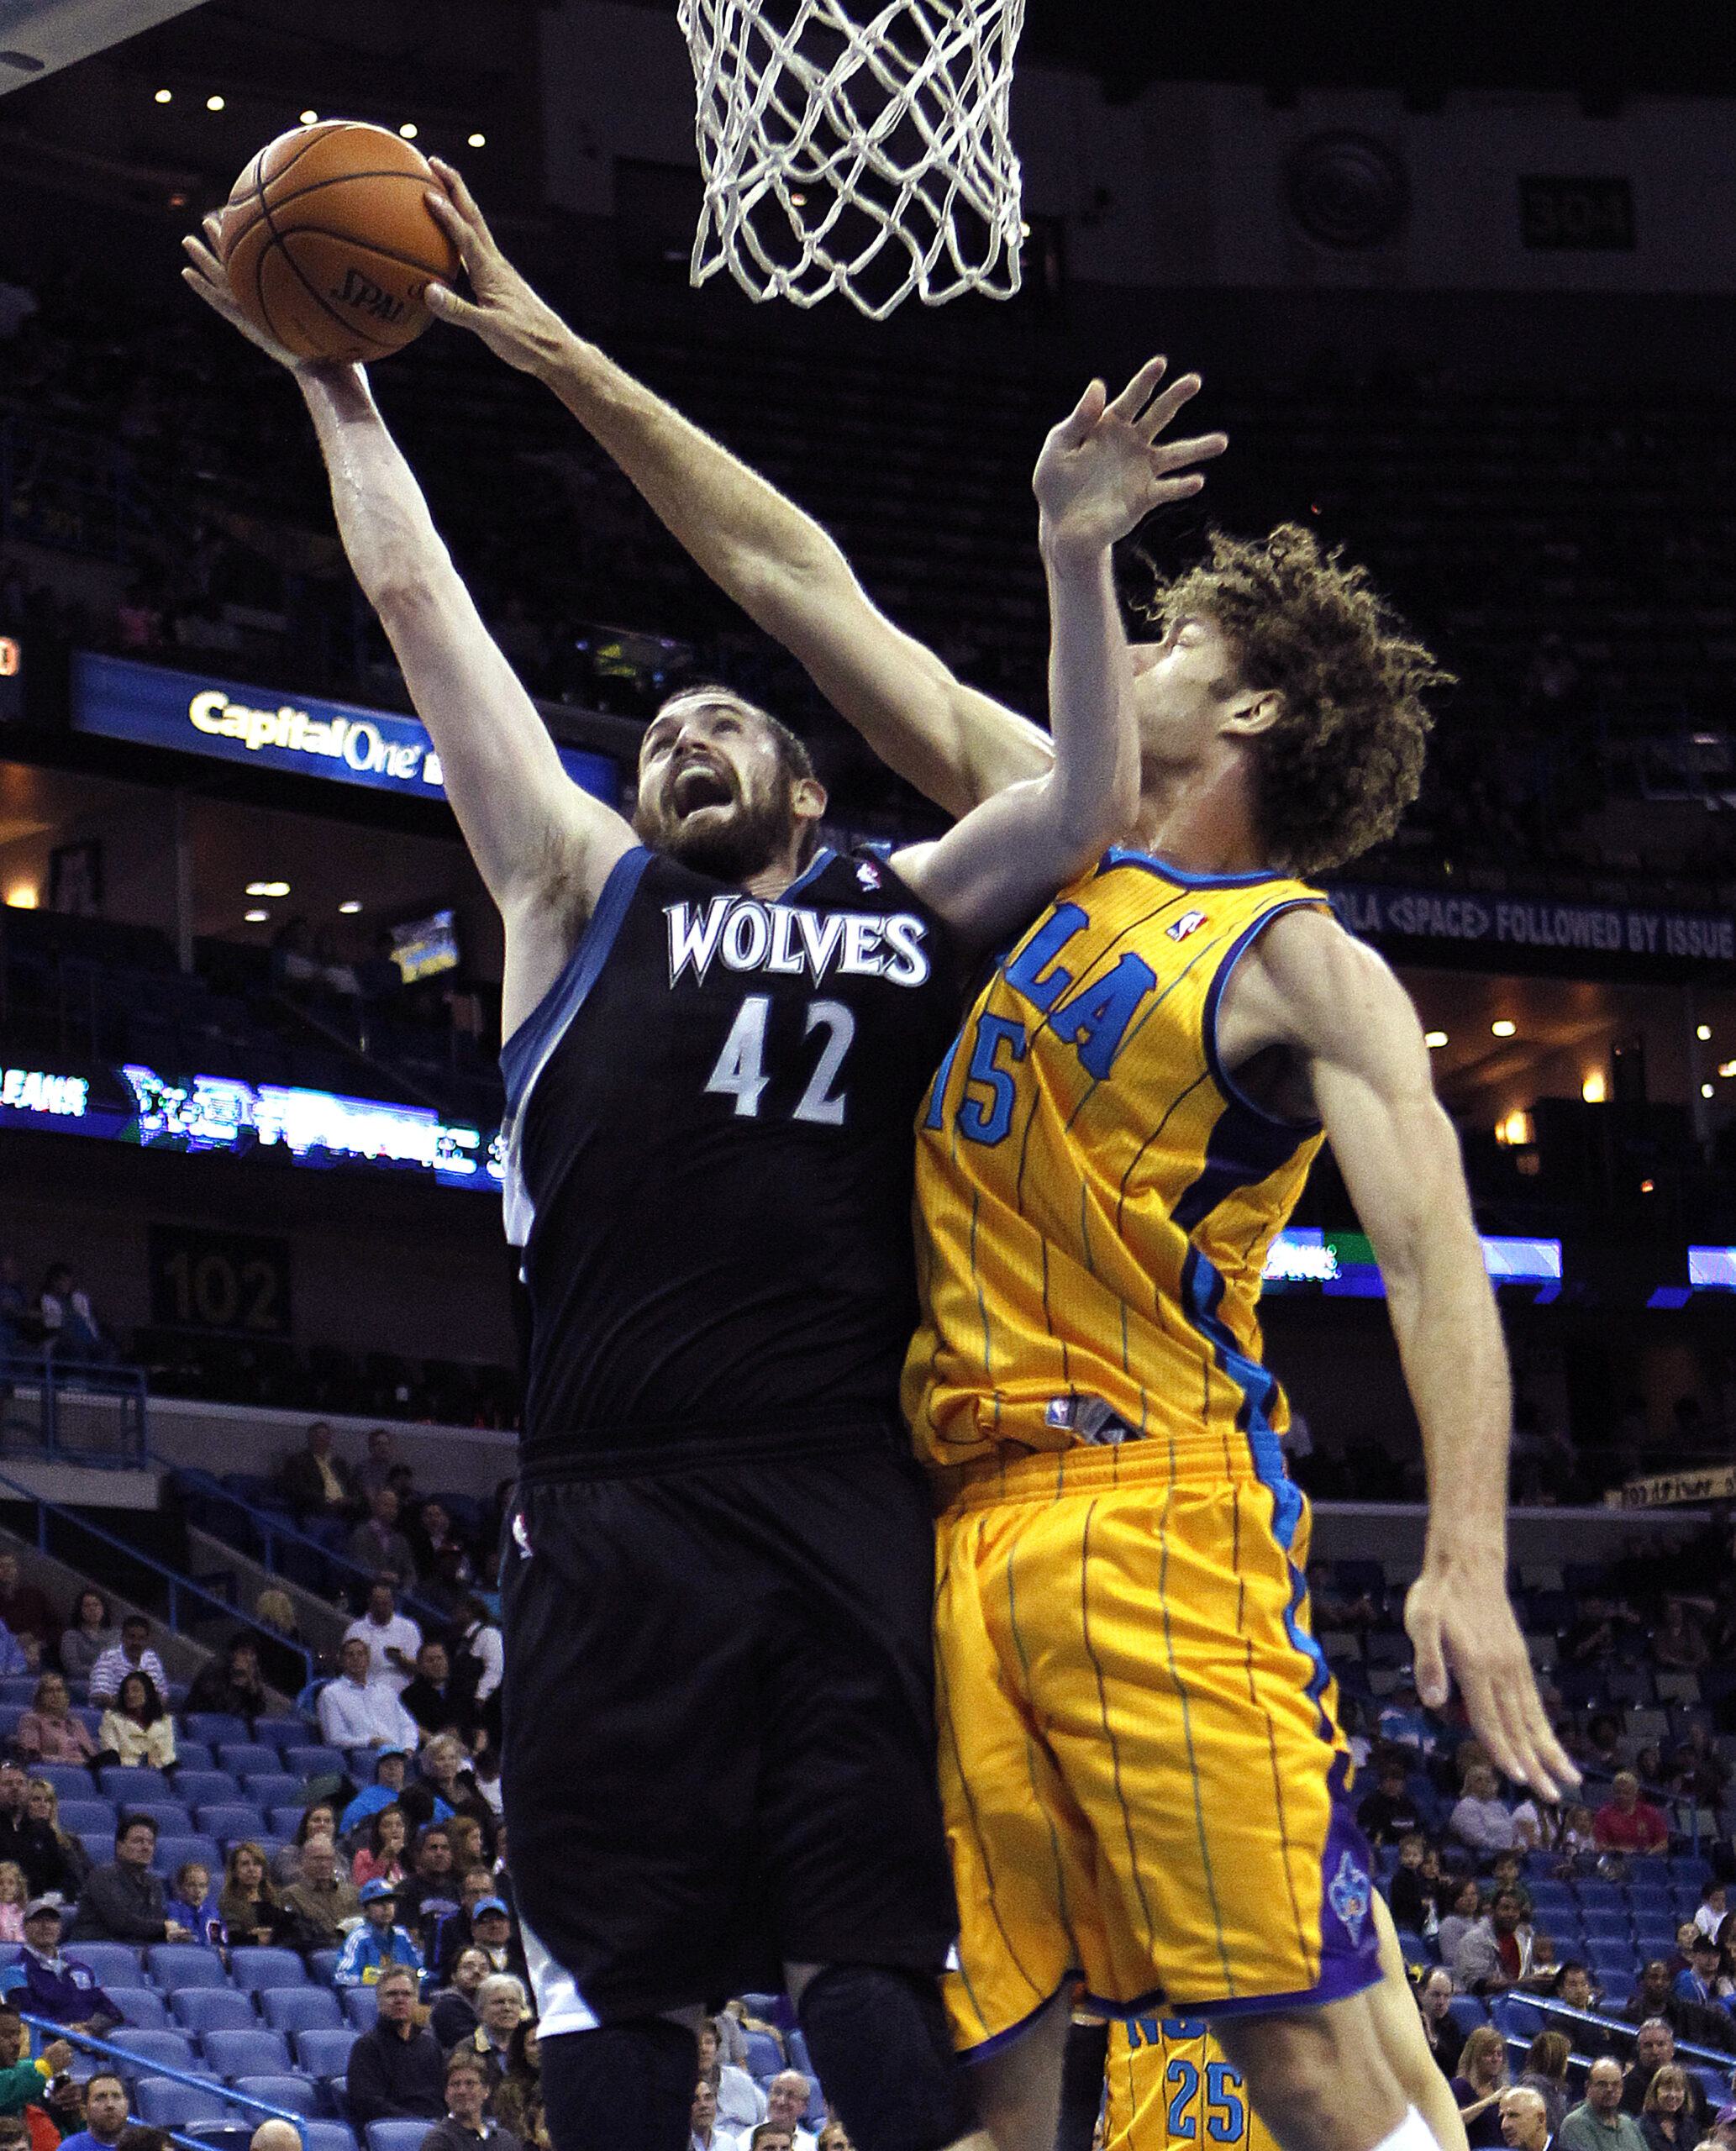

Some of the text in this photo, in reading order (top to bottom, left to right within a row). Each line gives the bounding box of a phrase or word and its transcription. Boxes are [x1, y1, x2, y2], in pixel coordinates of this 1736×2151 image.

[661, 893, 931, 990] WOLVES
[1494, 903, 1623, 951] FOLLOWED
[1627, 912, 1660, 954] BY
[1665, 917, 1734, 960] ISSUE
[703, 994, 855, 1126] 42
[163, 1250, 279, 1329] 102
[1167, 2059, 1244, 2143] 25
